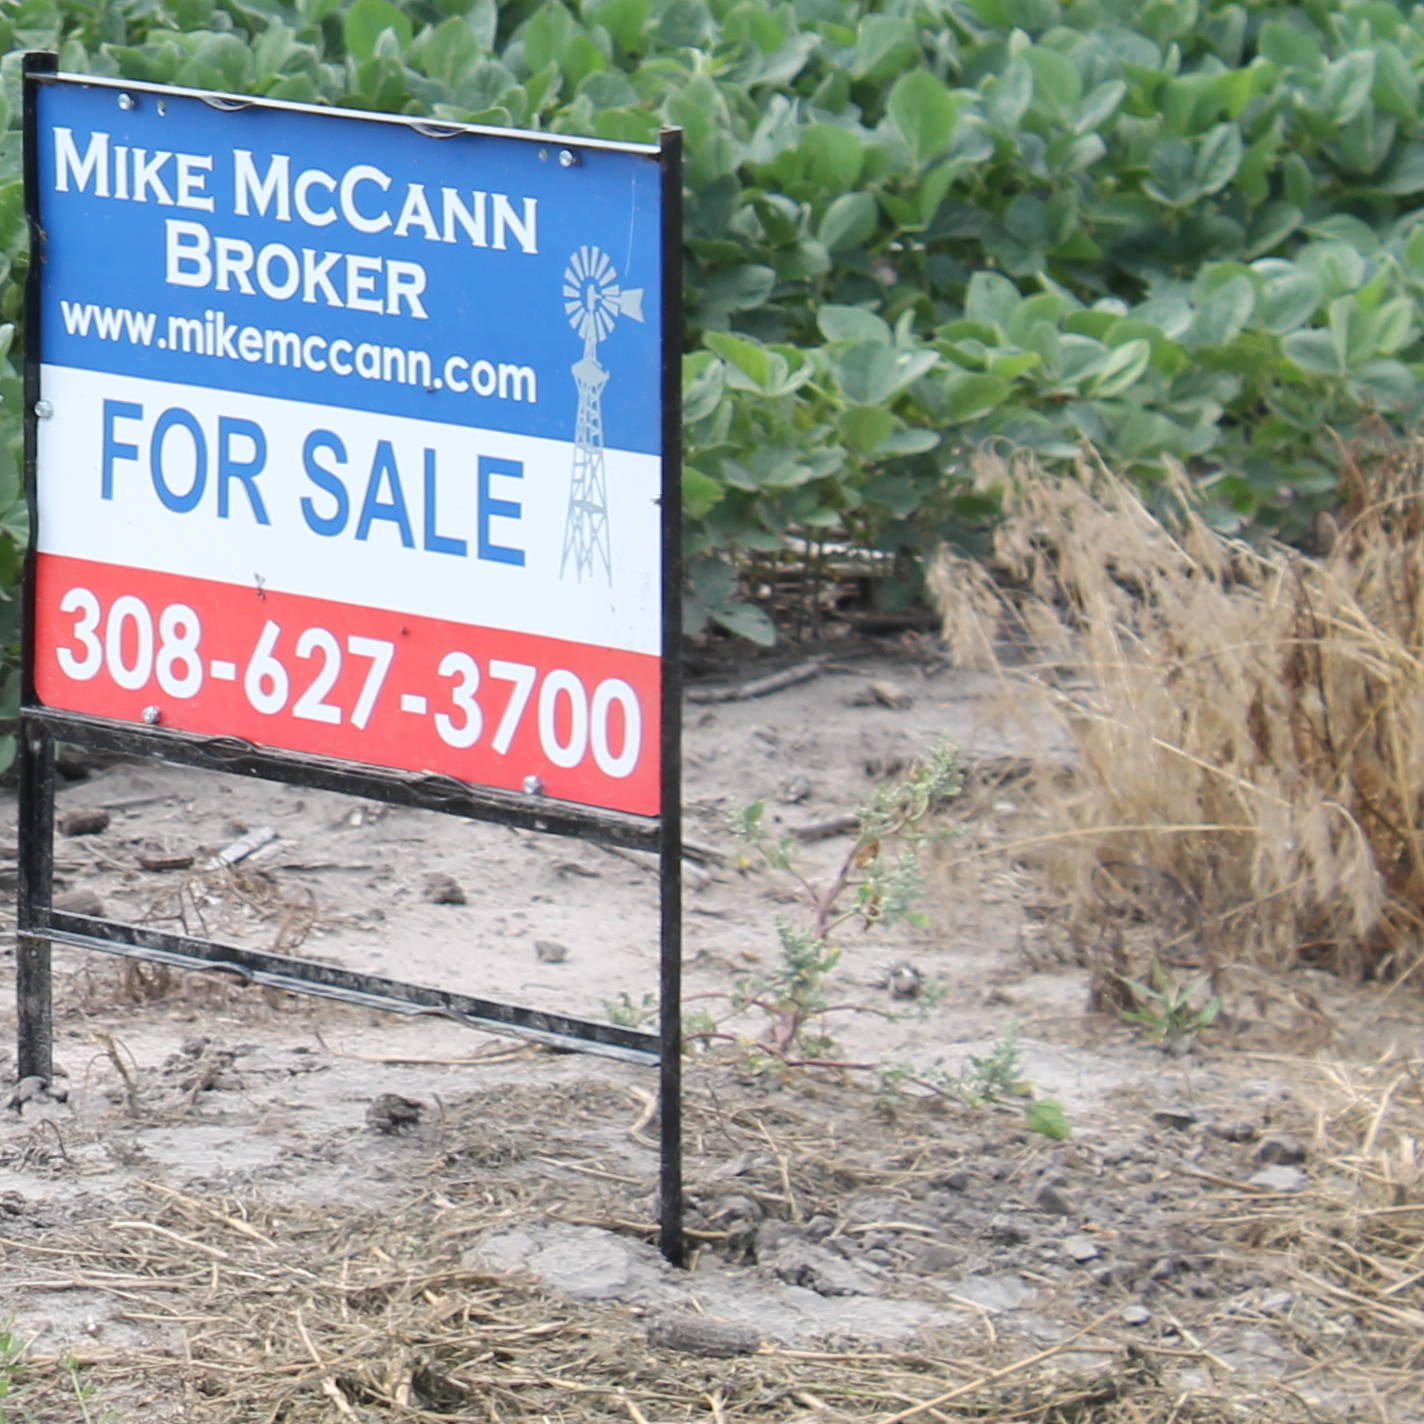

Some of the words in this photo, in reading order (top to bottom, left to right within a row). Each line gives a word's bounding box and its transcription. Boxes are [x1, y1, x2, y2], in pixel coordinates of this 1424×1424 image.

[60, 300, 537, 403] www.mikemccann.com
[101, 398, 271, 526] FOR
[300, 428, 526, 567] SALE
[55, 586, 642, 779] 308-627-3700
